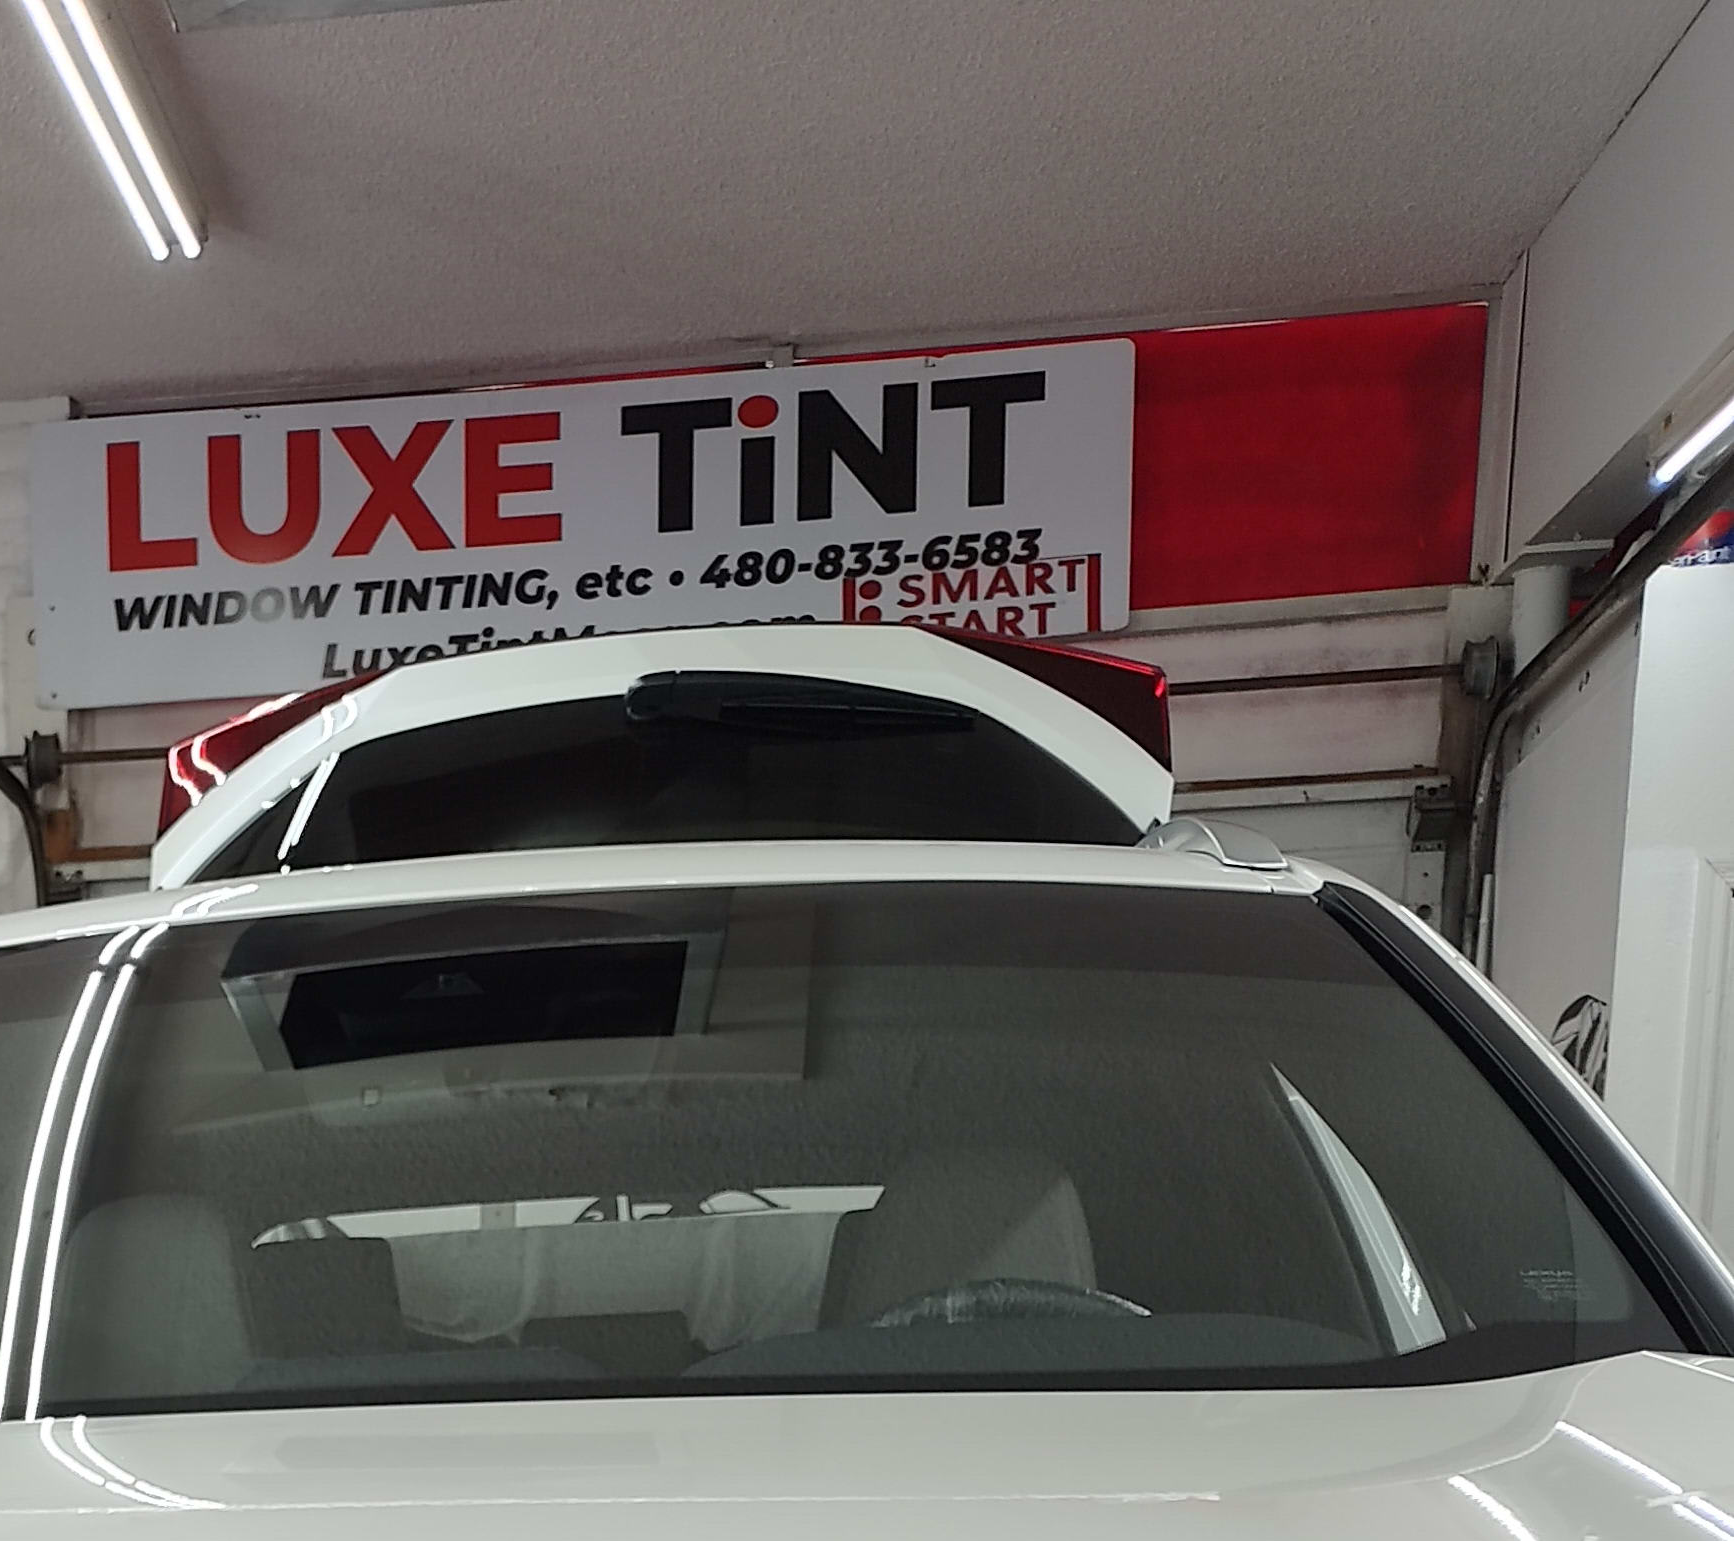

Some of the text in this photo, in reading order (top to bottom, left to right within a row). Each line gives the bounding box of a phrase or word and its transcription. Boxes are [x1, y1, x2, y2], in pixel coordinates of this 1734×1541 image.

[105, 371, 1046, 572] LUXE TiNT
[114, 528, 1043, 632] WINDOW TINTING, etc 480-833-6583
[896, 558, 1086, 608] SMART
[900, 602, 1056, 636] ART
